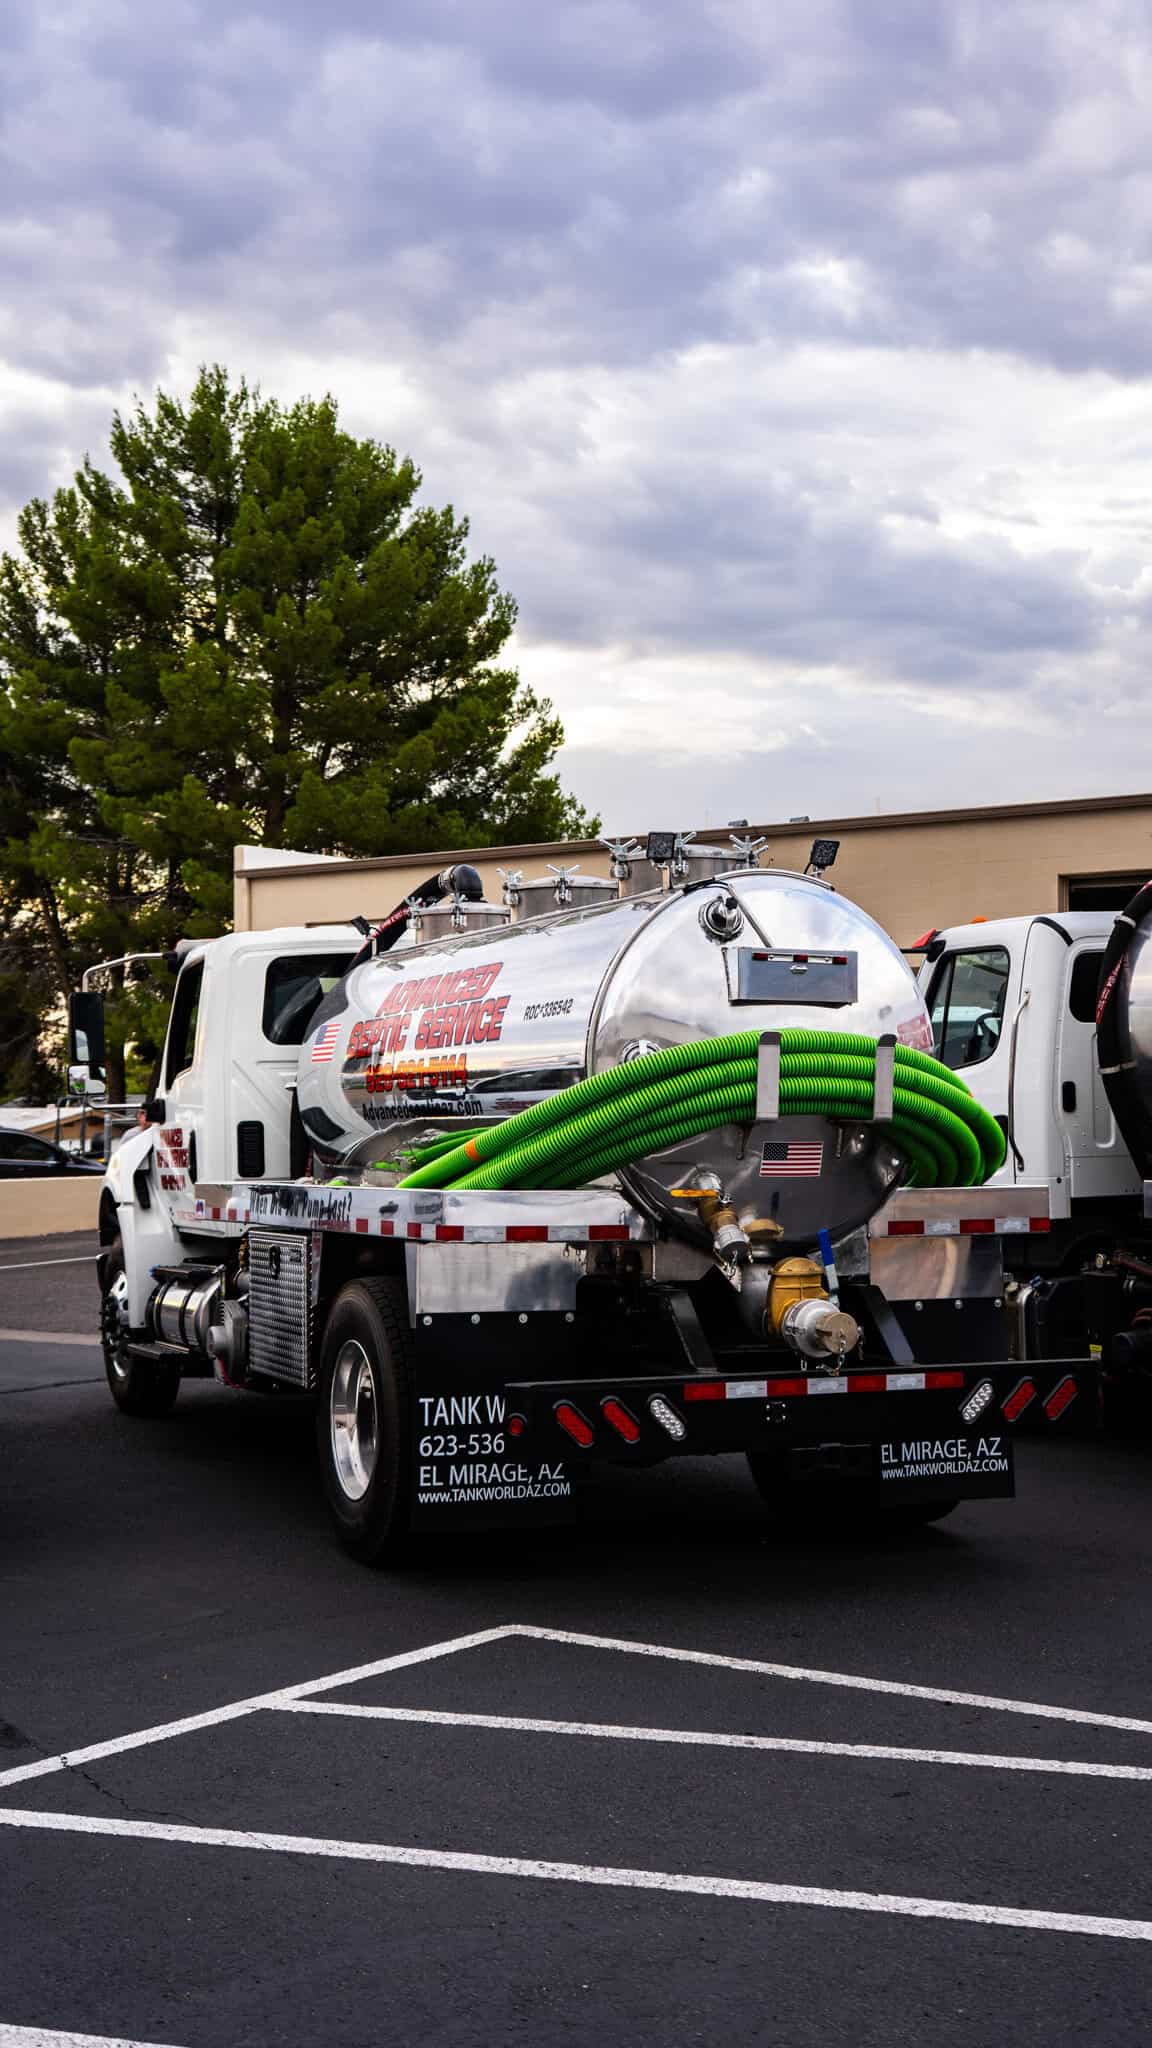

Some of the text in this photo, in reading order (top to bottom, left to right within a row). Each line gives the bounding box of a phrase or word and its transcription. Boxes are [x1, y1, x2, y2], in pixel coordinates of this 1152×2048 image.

[376, 962, 504, 1017] ADVANCED
[346, 995, 511, 1060] SEPTIC SERVICE
[419, 1395, 506, 1427] TANK W
[419, 1432, 505, 1457] 623-536
[880, 1436, 1002, 1464] EL MIRAGE, AZ
[419, 1462, 565, 1487] EL MIRAGE, AZ
